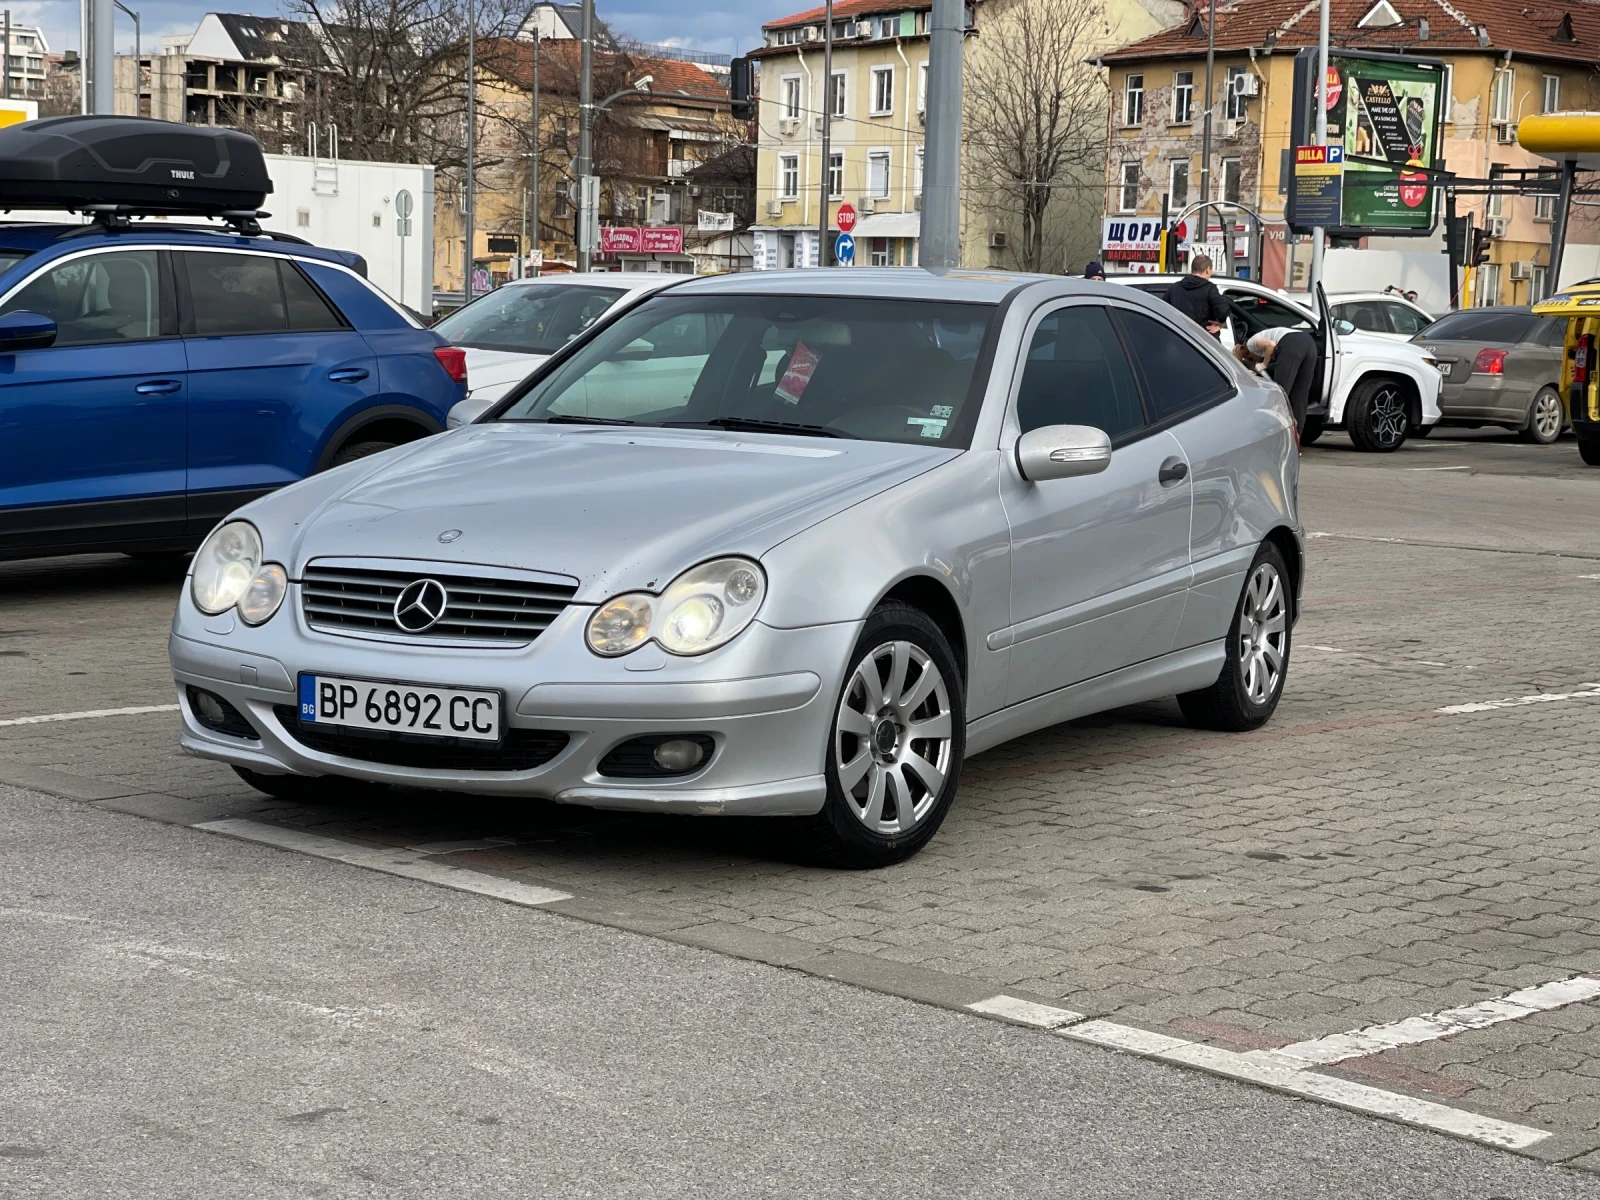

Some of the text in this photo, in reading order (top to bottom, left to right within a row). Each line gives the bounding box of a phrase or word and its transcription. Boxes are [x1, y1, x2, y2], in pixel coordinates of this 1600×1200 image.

[1326, 74, 1337, 84] LLA
[1365, 96, 1391, 104] CASTELLO
[1298, 148, 1340, 161] BILLA P
[170, 170, 195, 180] THULE
[838, 213, 855, 224] STOP
[1270, 231, 1285, 240] УЮ
[1107, 250, 1156, 261] МАГАЗИН ЗА
[303, 703, 314, 715] BG
[320, 682, 492, 734] BP 6892 CC
